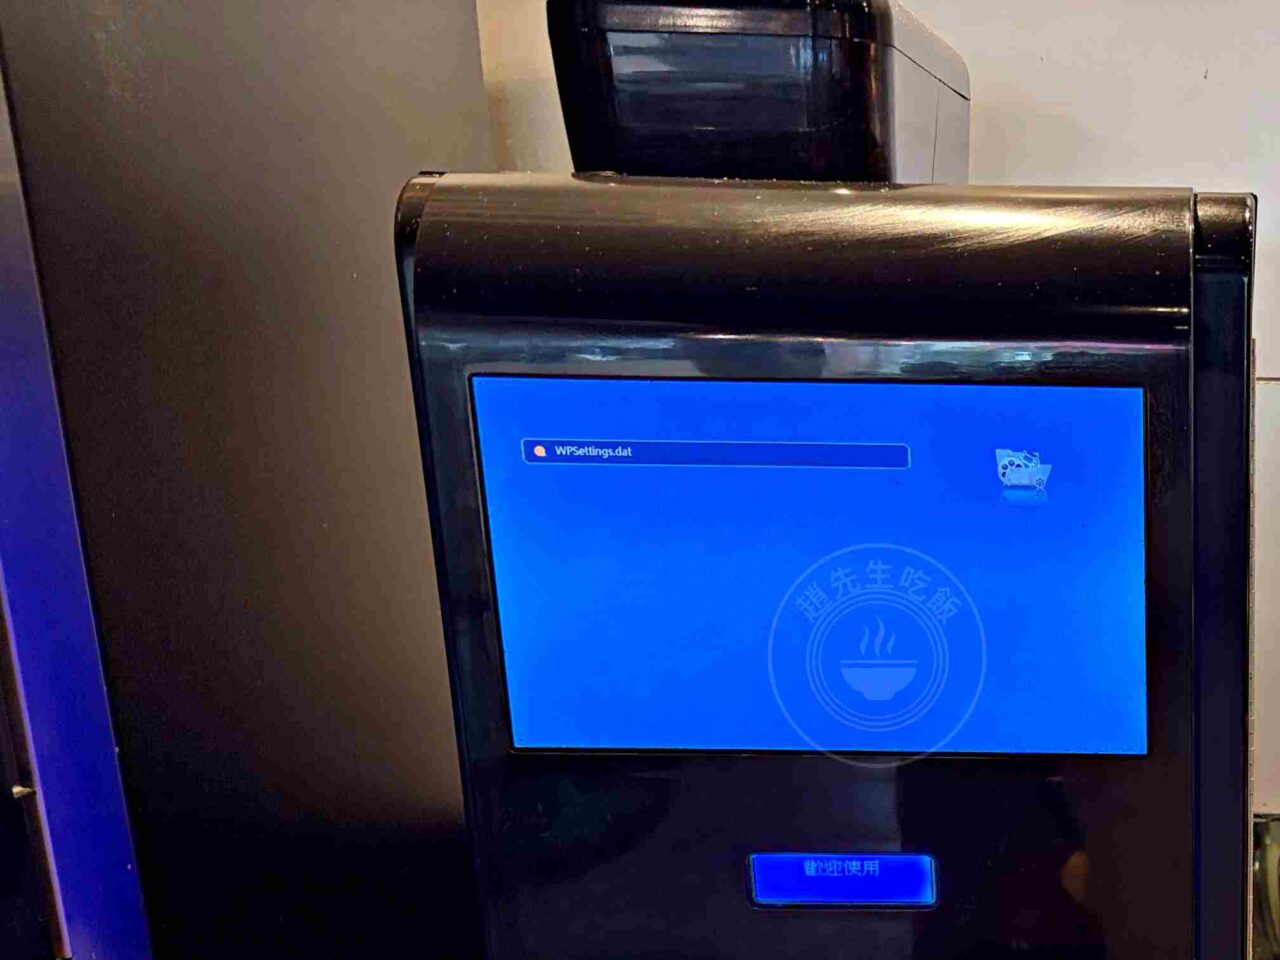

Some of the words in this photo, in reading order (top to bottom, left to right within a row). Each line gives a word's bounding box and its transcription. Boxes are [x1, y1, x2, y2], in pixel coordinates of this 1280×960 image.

[554, 445, 633, 459] WPSettings.dat
[804, 859, 879, 877] 歡迎使用
